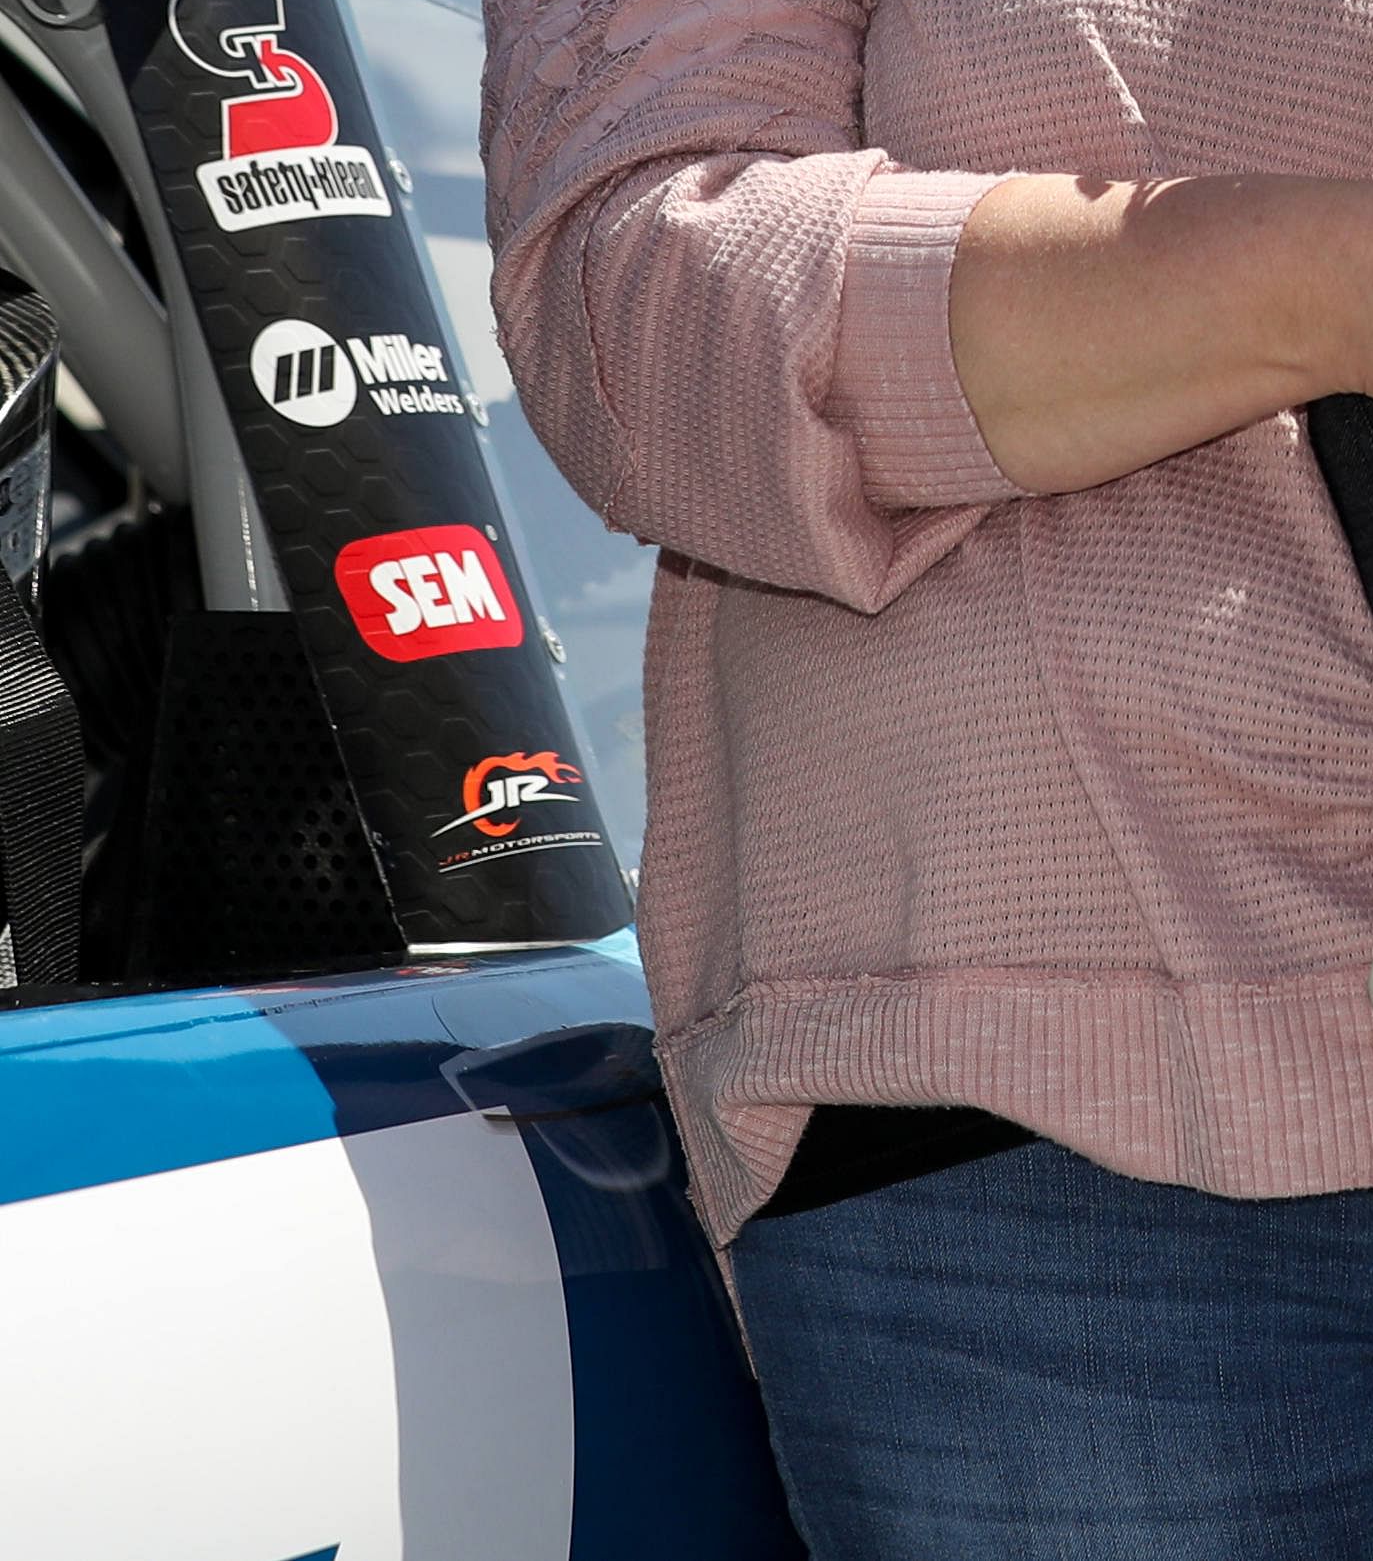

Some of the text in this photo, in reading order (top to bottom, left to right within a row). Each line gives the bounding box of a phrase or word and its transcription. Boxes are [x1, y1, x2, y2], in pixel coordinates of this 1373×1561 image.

[217, 156, 383, 215] safety-kleen
[347, 334, 448, 385] Miller
[369, 385, 464, 416] Welders
[369, 550, 507, 636] SEM
